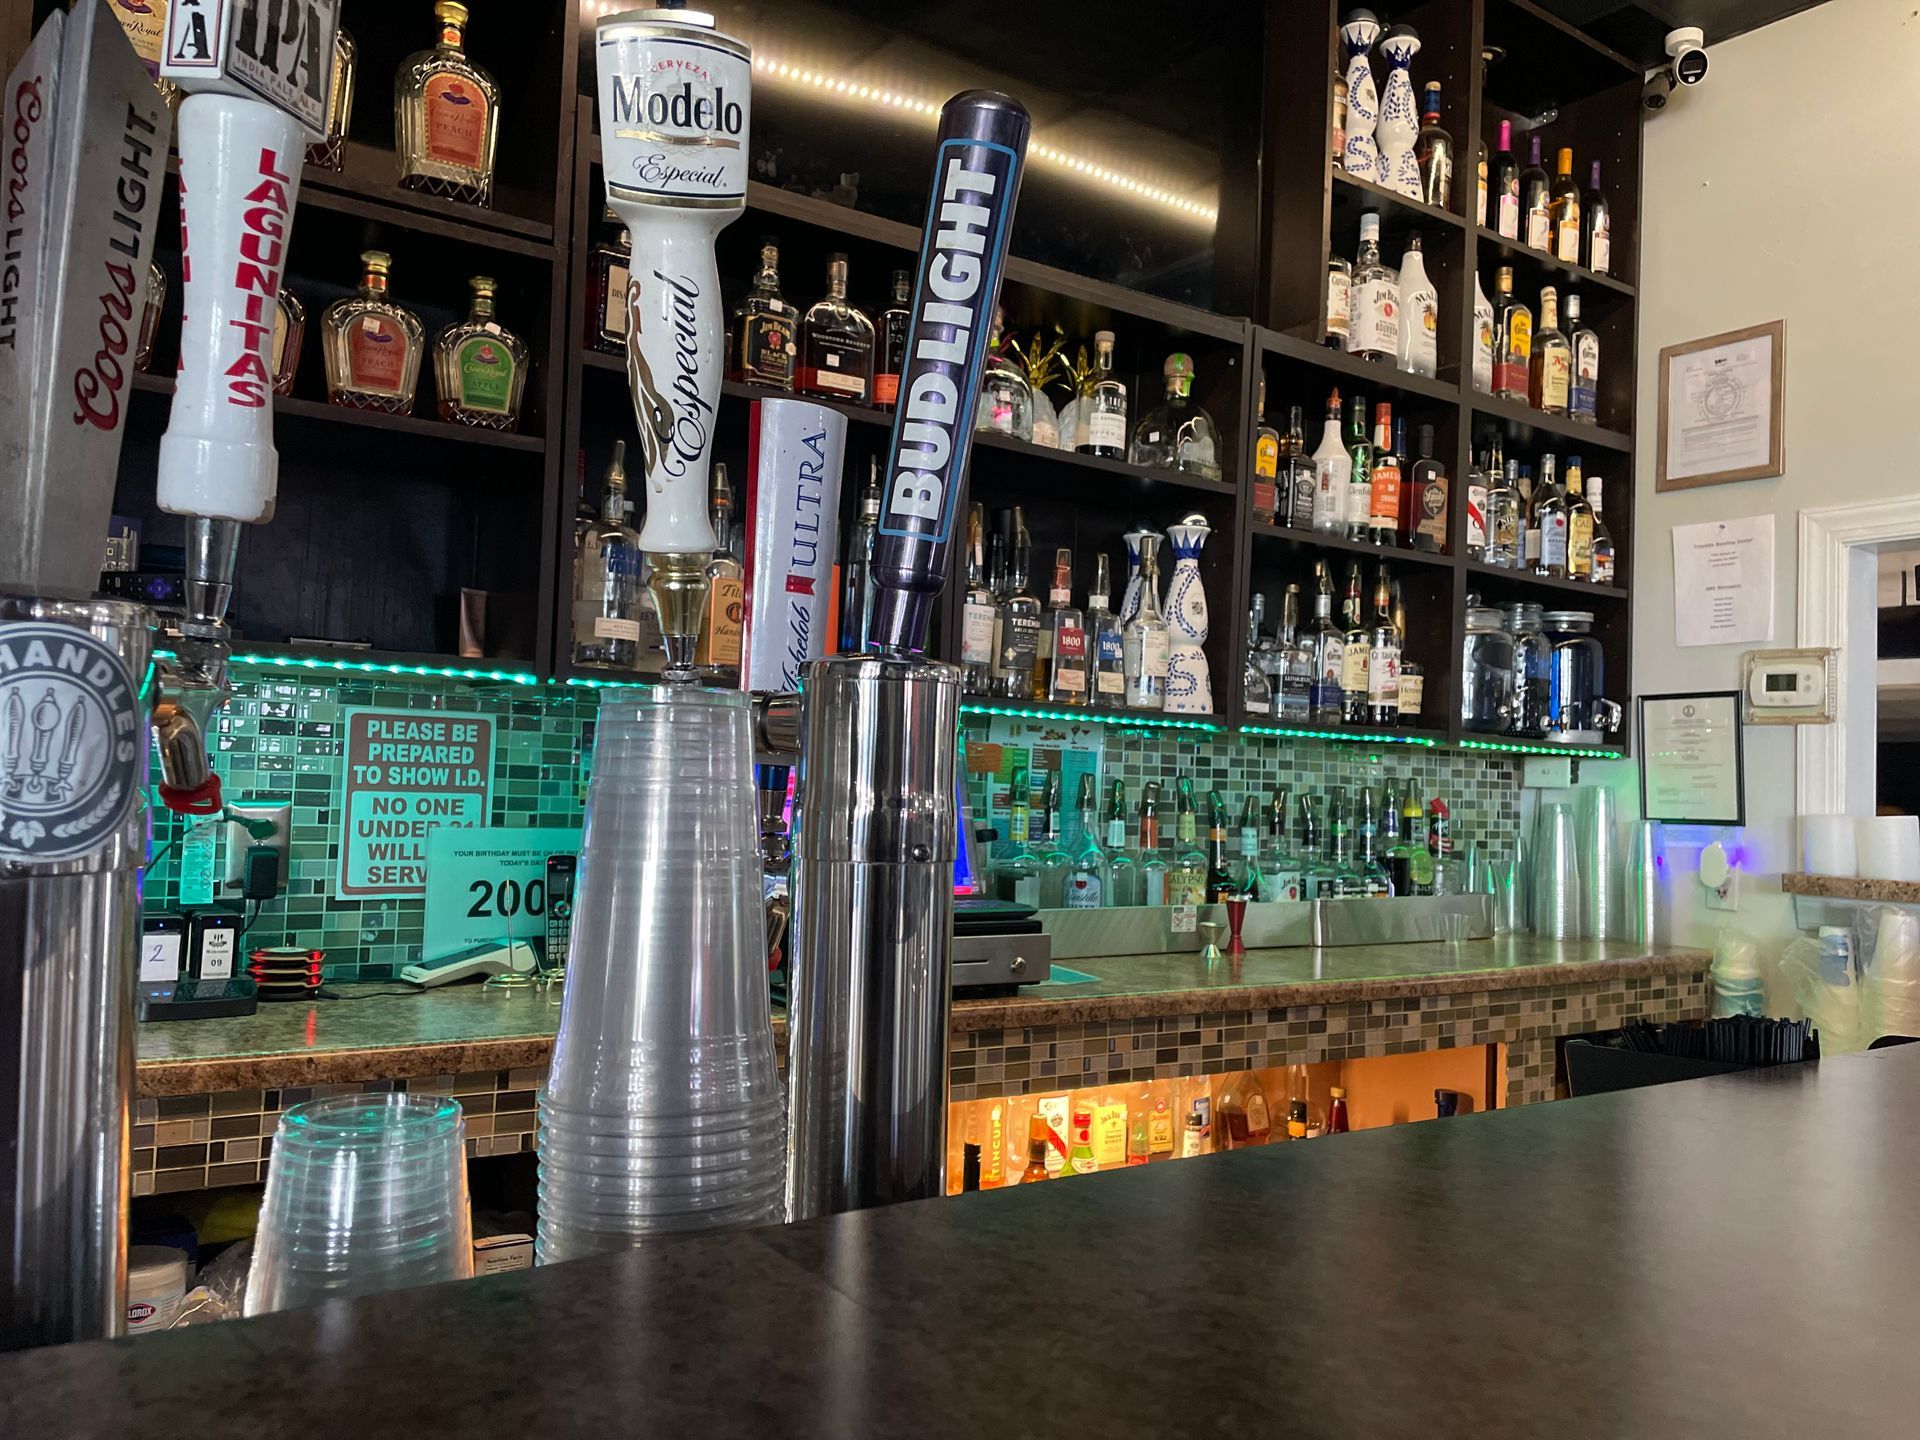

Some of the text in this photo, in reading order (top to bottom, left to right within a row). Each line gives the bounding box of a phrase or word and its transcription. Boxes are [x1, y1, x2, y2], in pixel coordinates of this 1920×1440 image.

[651, 59, 710, 80] CERVEZA
[612, 74, 743, 135] Modelo
[632, 153, 725, 189] Especial
[0, 75, 42, 352] Coors LIGHT
[74, 260, 137, 431] Coors
[109, 102, 157, 259] LIGHT
[224, 148, 290, 408] LAGUNITAS
[890, 158, 997, 521] BUD LIGHT
[781, 428, 828, 692] Mhelob ULTRA
[1062, 635, 1081, 647] 1800
[1103, 640, 1120, 652] 1800
[367, 719, 478, 743] PLEASE BE
[368, 743, 475, 765] PREPARED
[353, 765, 486, 787] TO SHOW I.D.
[372, 797, 464, 816] NO ONE
[367, 843, 425, 861] WILL
[500, 859, 529, 867] TODAY'S
[367, 866, 427, 884] SERV
[467, 879, 546, 918] 200
[149, 944, 166, 962] 2
[210, 958, 223, 967] 09
[128, 1306, 152, 1319] LOROX
